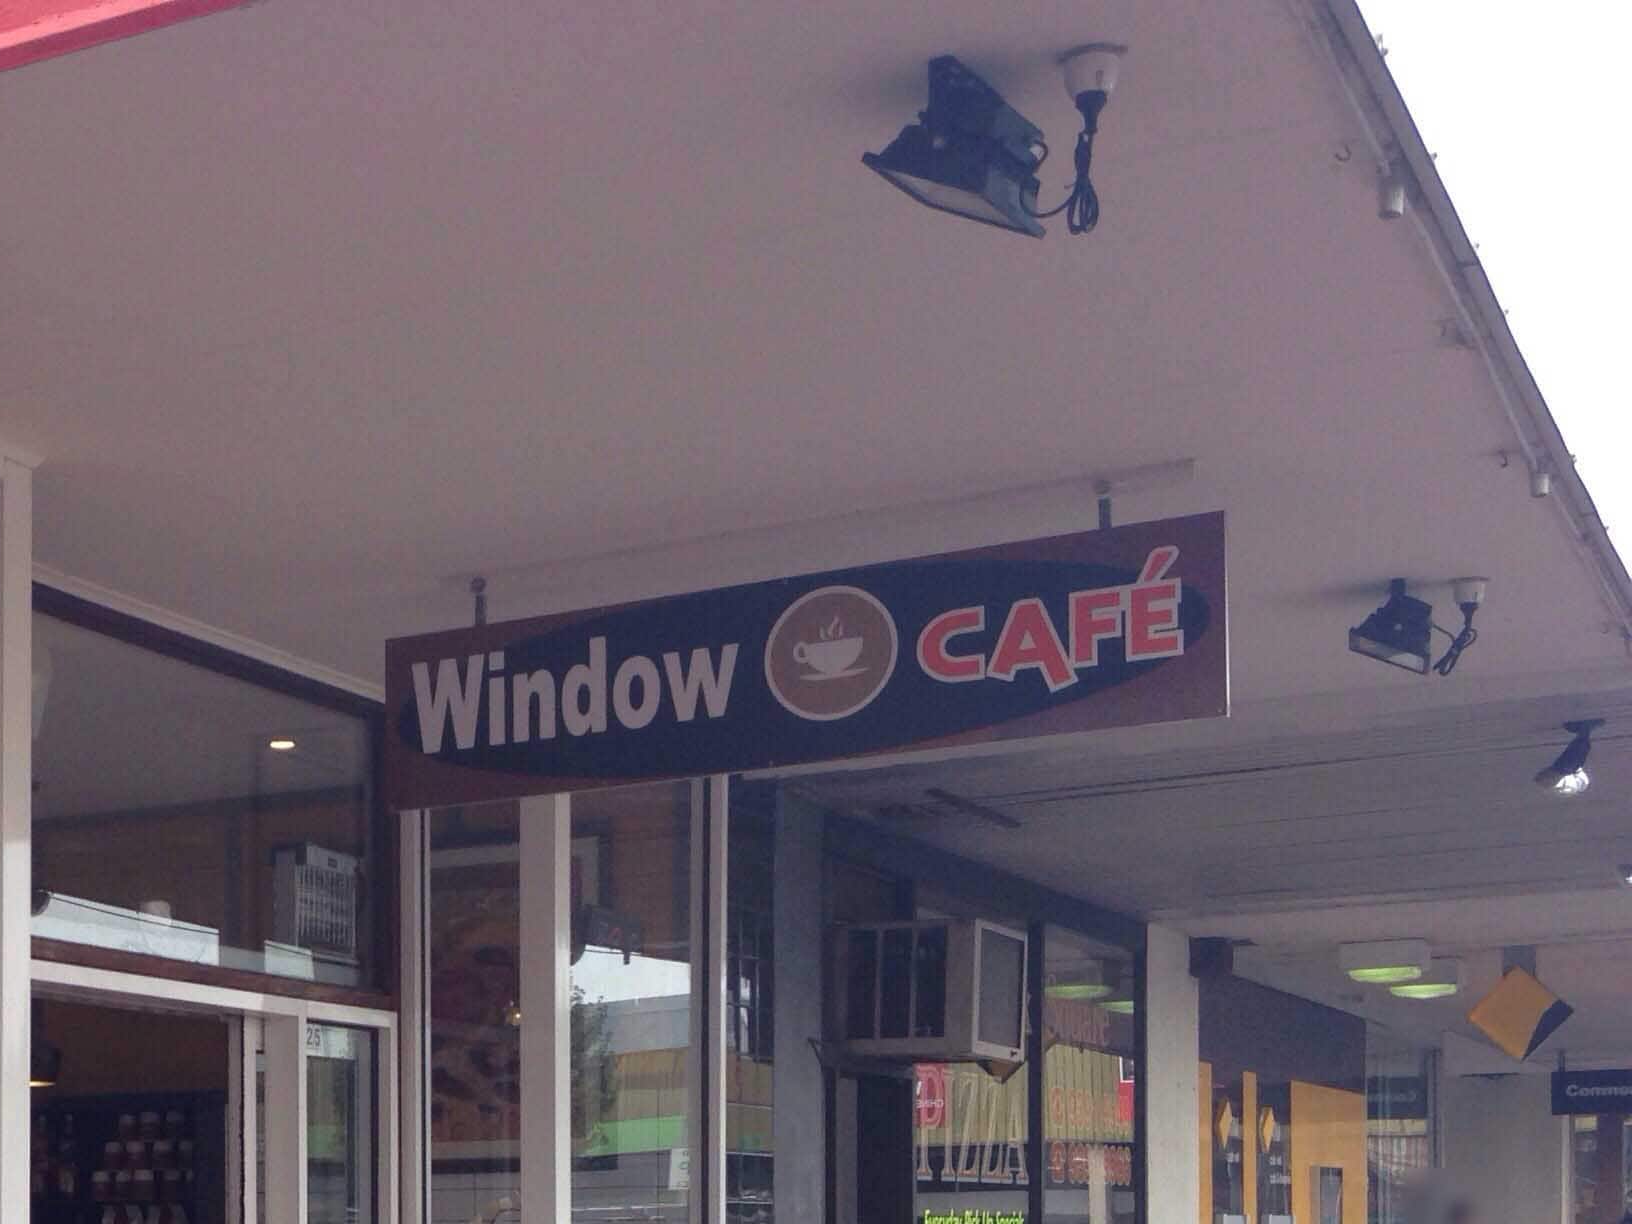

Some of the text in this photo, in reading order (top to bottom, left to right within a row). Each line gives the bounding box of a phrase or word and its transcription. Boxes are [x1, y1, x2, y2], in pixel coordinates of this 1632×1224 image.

[411, 545, 1185, 756] Window CAFÉ
[915, 1064, 1030, 1185] PIZZA
